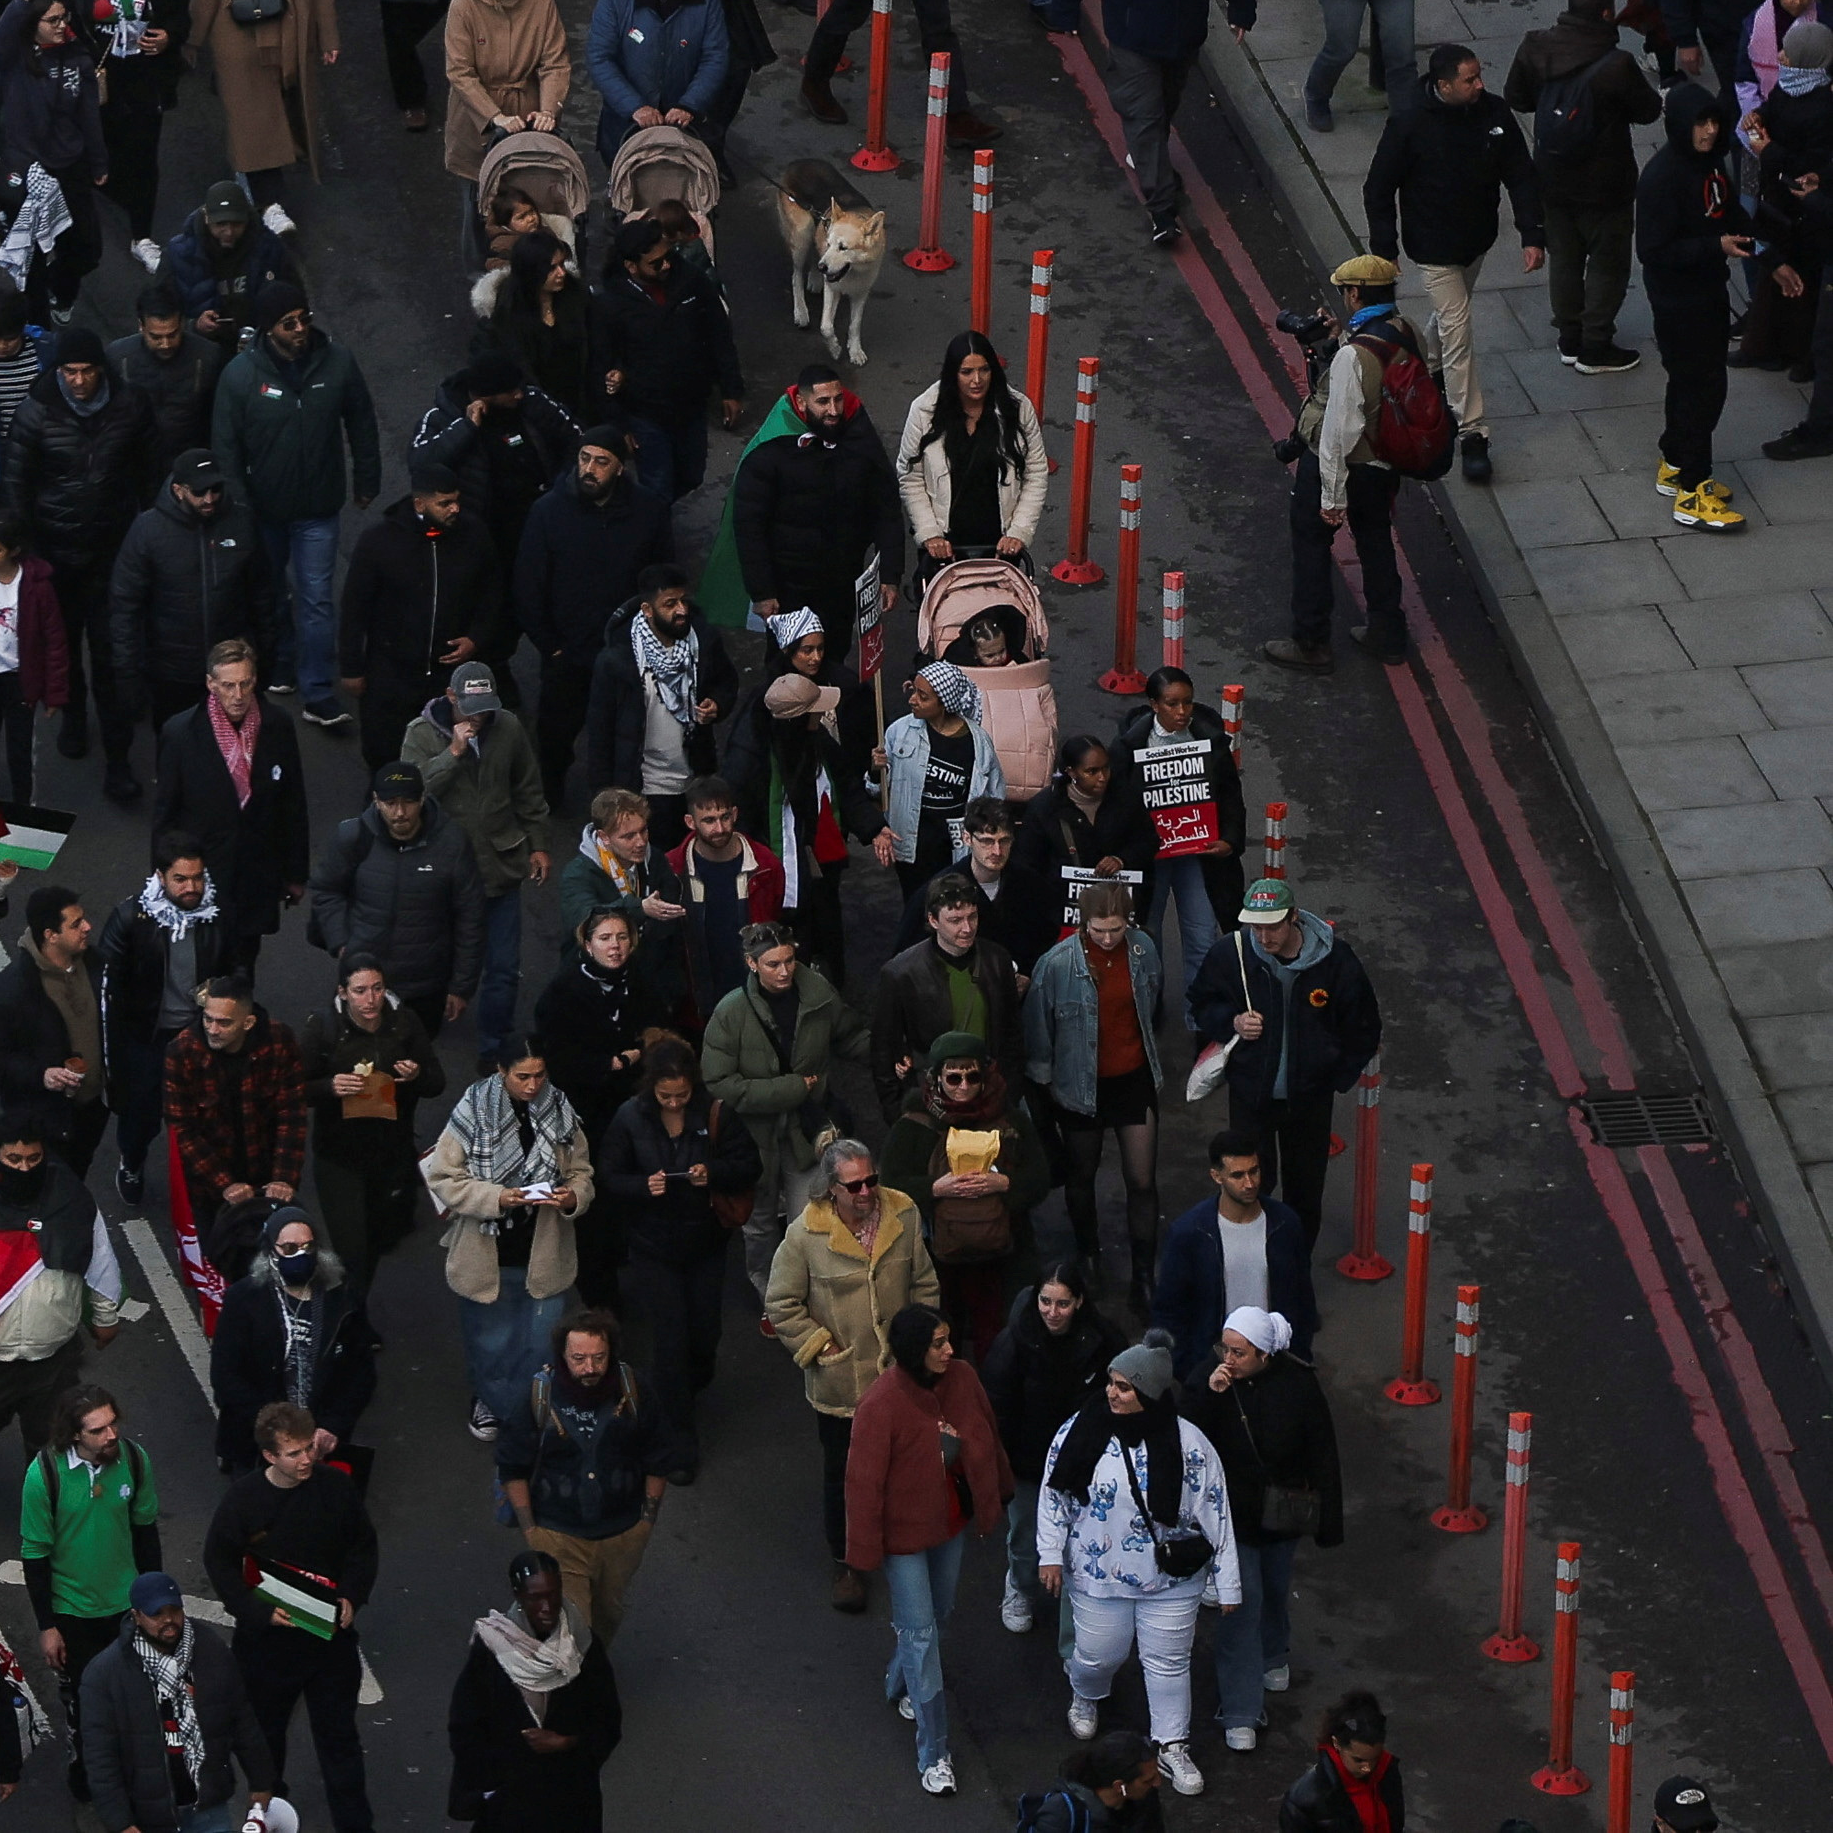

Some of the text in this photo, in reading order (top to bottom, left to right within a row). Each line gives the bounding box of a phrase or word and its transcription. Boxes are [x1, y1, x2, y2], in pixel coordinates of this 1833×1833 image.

[1145, 745, 1199, 760] Socialist Worker
[926, 763, 966, 786] ESTINE
[1143, 756, 1205, 783] FREEDOM
[1170, 778, 1180, 786] for
[1143, 782, 1212, 809] PALESTINE
[1157, 809, 1201, 830] الحرية
[1073, 870, 1095, 879] Socia
